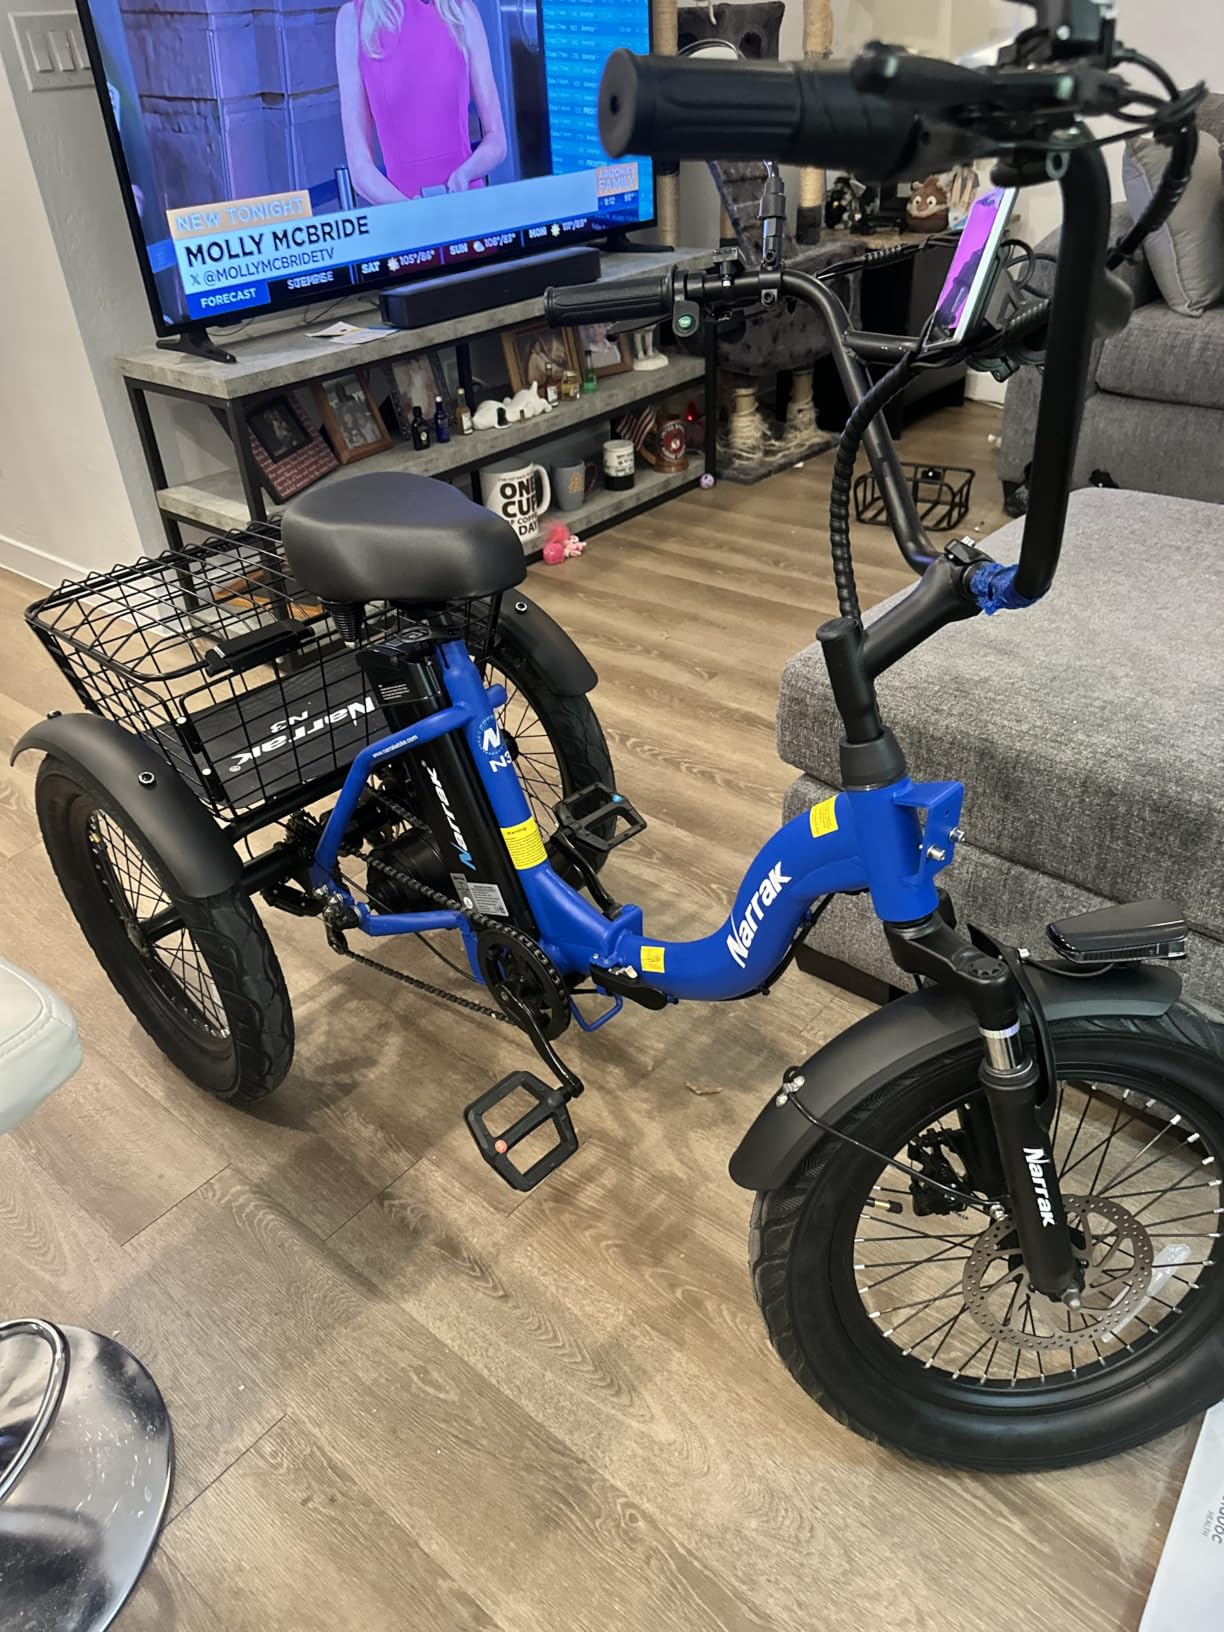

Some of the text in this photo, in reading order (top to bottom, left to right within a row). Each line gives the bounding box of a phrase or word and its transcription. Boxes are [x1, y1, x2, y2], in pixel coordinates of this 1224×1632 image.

[176, 198, 304, 233] NEW TONIGHT
[185, 215, 370, 267] MOLLY MCBRIDE
[201, 288, 257, 308] FORECAST
[362, 260, 381, 274] SAT
[449, 243, 468, 255] SUN
[205, 247, 335, 286] @MOLLYMCBRIDETV
[270, 710, 308, 733] N3
[489, 751, 512, 773] N3
[726, 861, 792, 969] Narrak
[1023, 1147, 1056, 1227] Narrak
